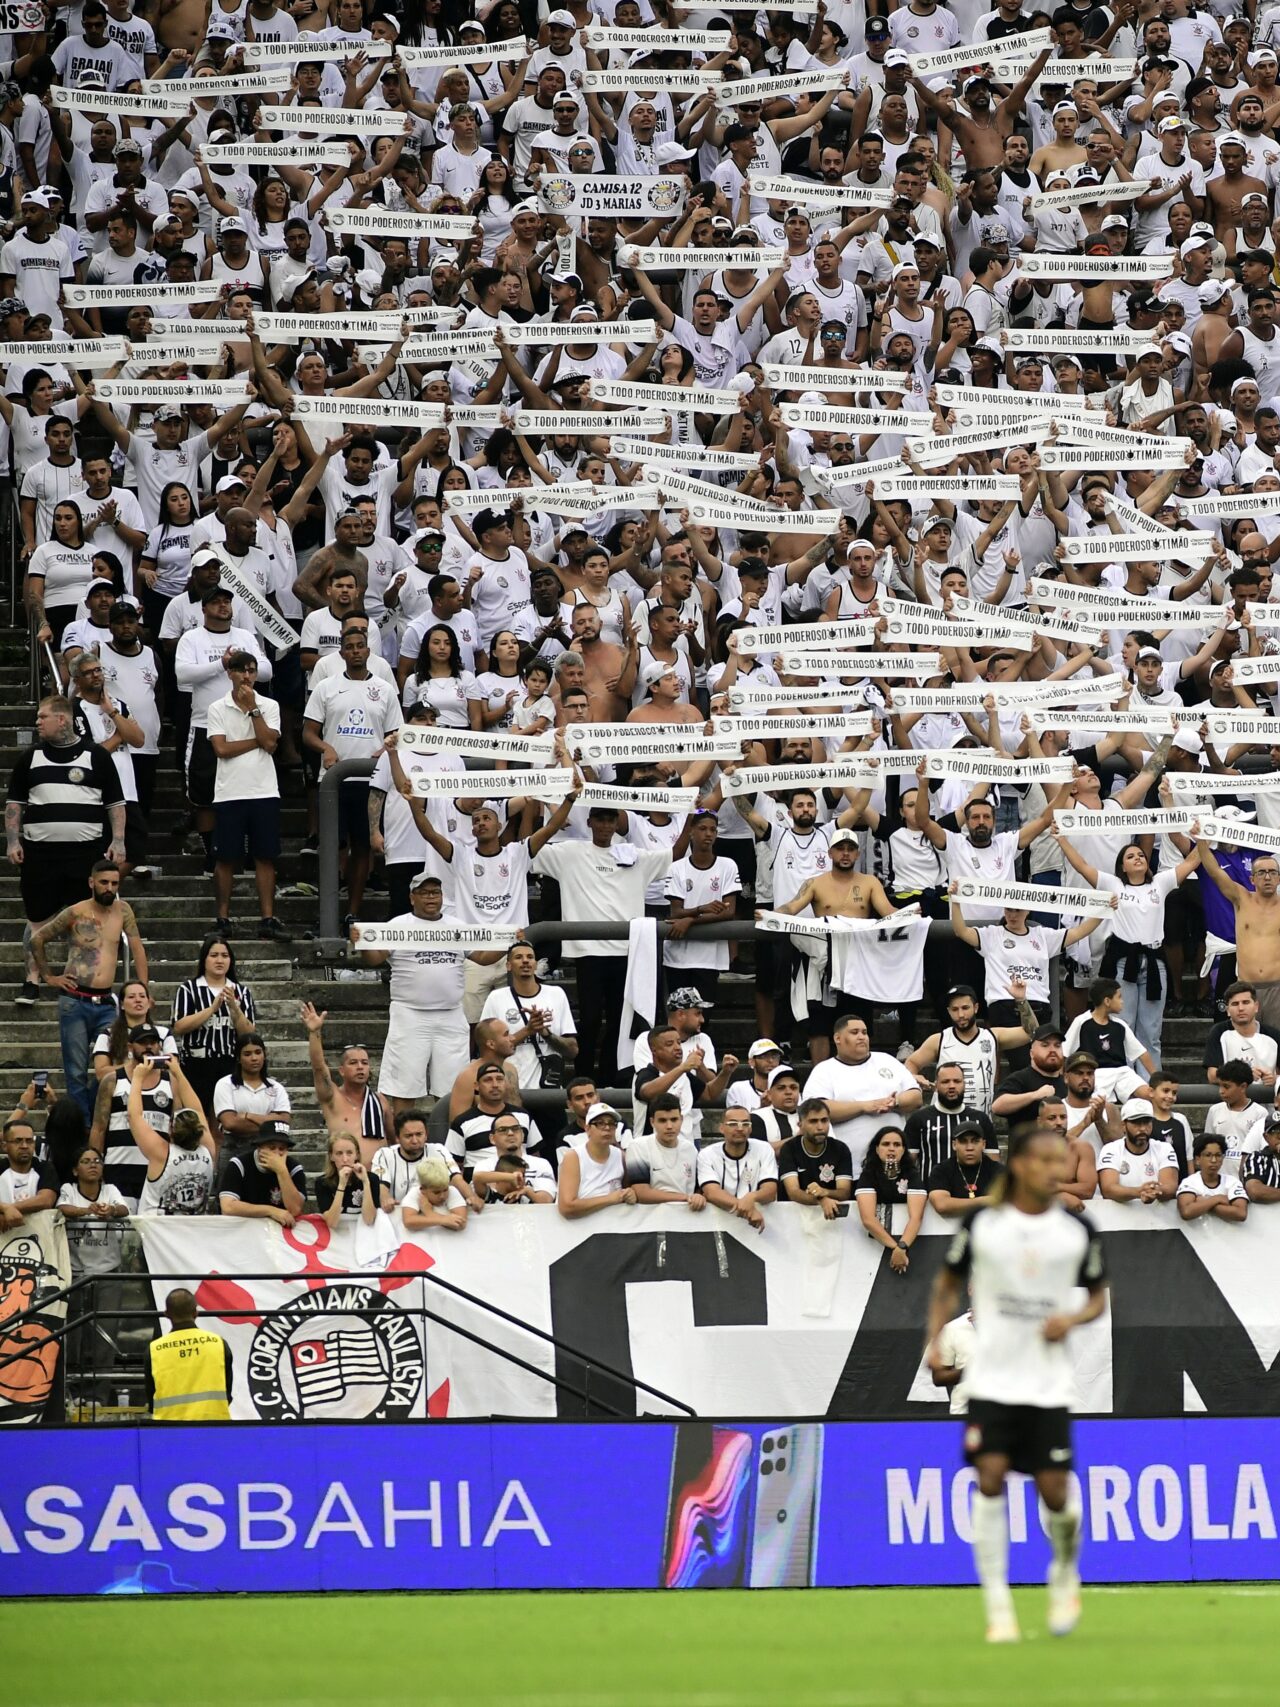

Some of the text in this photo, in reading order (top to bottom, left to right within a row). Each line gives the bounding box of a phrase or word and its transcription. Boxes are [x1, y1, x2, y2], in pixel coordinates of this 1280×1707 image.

[607, 32, 706, 44] TODO PODEROSO TIMÃO
[930, 36, 1028, 66] TODO PODEROSO TIMÃO
[71, 91, 168, 110] TODO PODEROSO TIMÃO
[280, 112, 382, 126] TODO PODEROSO TIMÃO
[222, 145, 325, 156] TODO PODEROSO TIMÃO
[582, 183, 642, 194] CAMISA 12
[580, 197, 642, 210] JD 3 MARIAS
[348, 214, 450, 230] TODO PODEROSO TIMÃO
[659, 251, 761, 263] TODO PODEROSO TIMÃO
[1044, 261, 1147, 272] TODO PODEROSO TIMÃO
[89, 284, 195, 299] TODO PODEROSO TIMÃO
[274, 318, 377, 331] TODO PODEROSO TIMÃO
[789, 338, 803, 354] 12
[784, 371, 884, 387] TODO PODEROSO TIMÃO
[116, 384, 222, 395] TODO PODEROSO TIMÃO
[314, 401, 419, 418] TODO PODEROSO TIMÃO
[535, 415, 641, 427] TODO PODEROSO TIMÃO
[896, 478, 996, 490] TODO PODEROSO TIMÃO
[1084, 536, 1190, 554] TODO PODEROSO TIMÃO
[758, 624, 866, 645] TODO PODEROSO TIMÃO
[806, 658, 914, 669] TODO PODEROSO TIMÃO
[420, 733, 529, 752] TODO PODEROSO TIMÃO
[947, 760, 1051, 777] TODO PODEROSO TIMÃO
[435, 774, 547, 789] TODO PODEROSO TIMÃO
[1078, 811, 1188, 827] TODO PODEROSO TIMÃO
[1220, 826, 1247, 841] TODO
[978, 885, 1087, 907] TODO PODEROSO TIMÃO
[381, 928, 492, 942] TODO PODEROSO TIMÃO
[180, 1190, 194, 1202] 12
[18, 1242, 30, 1256] 9
[156, 1336, 218, 1351] ORIENTAÇÃO
[179, 1348, 200, 1358] 871
